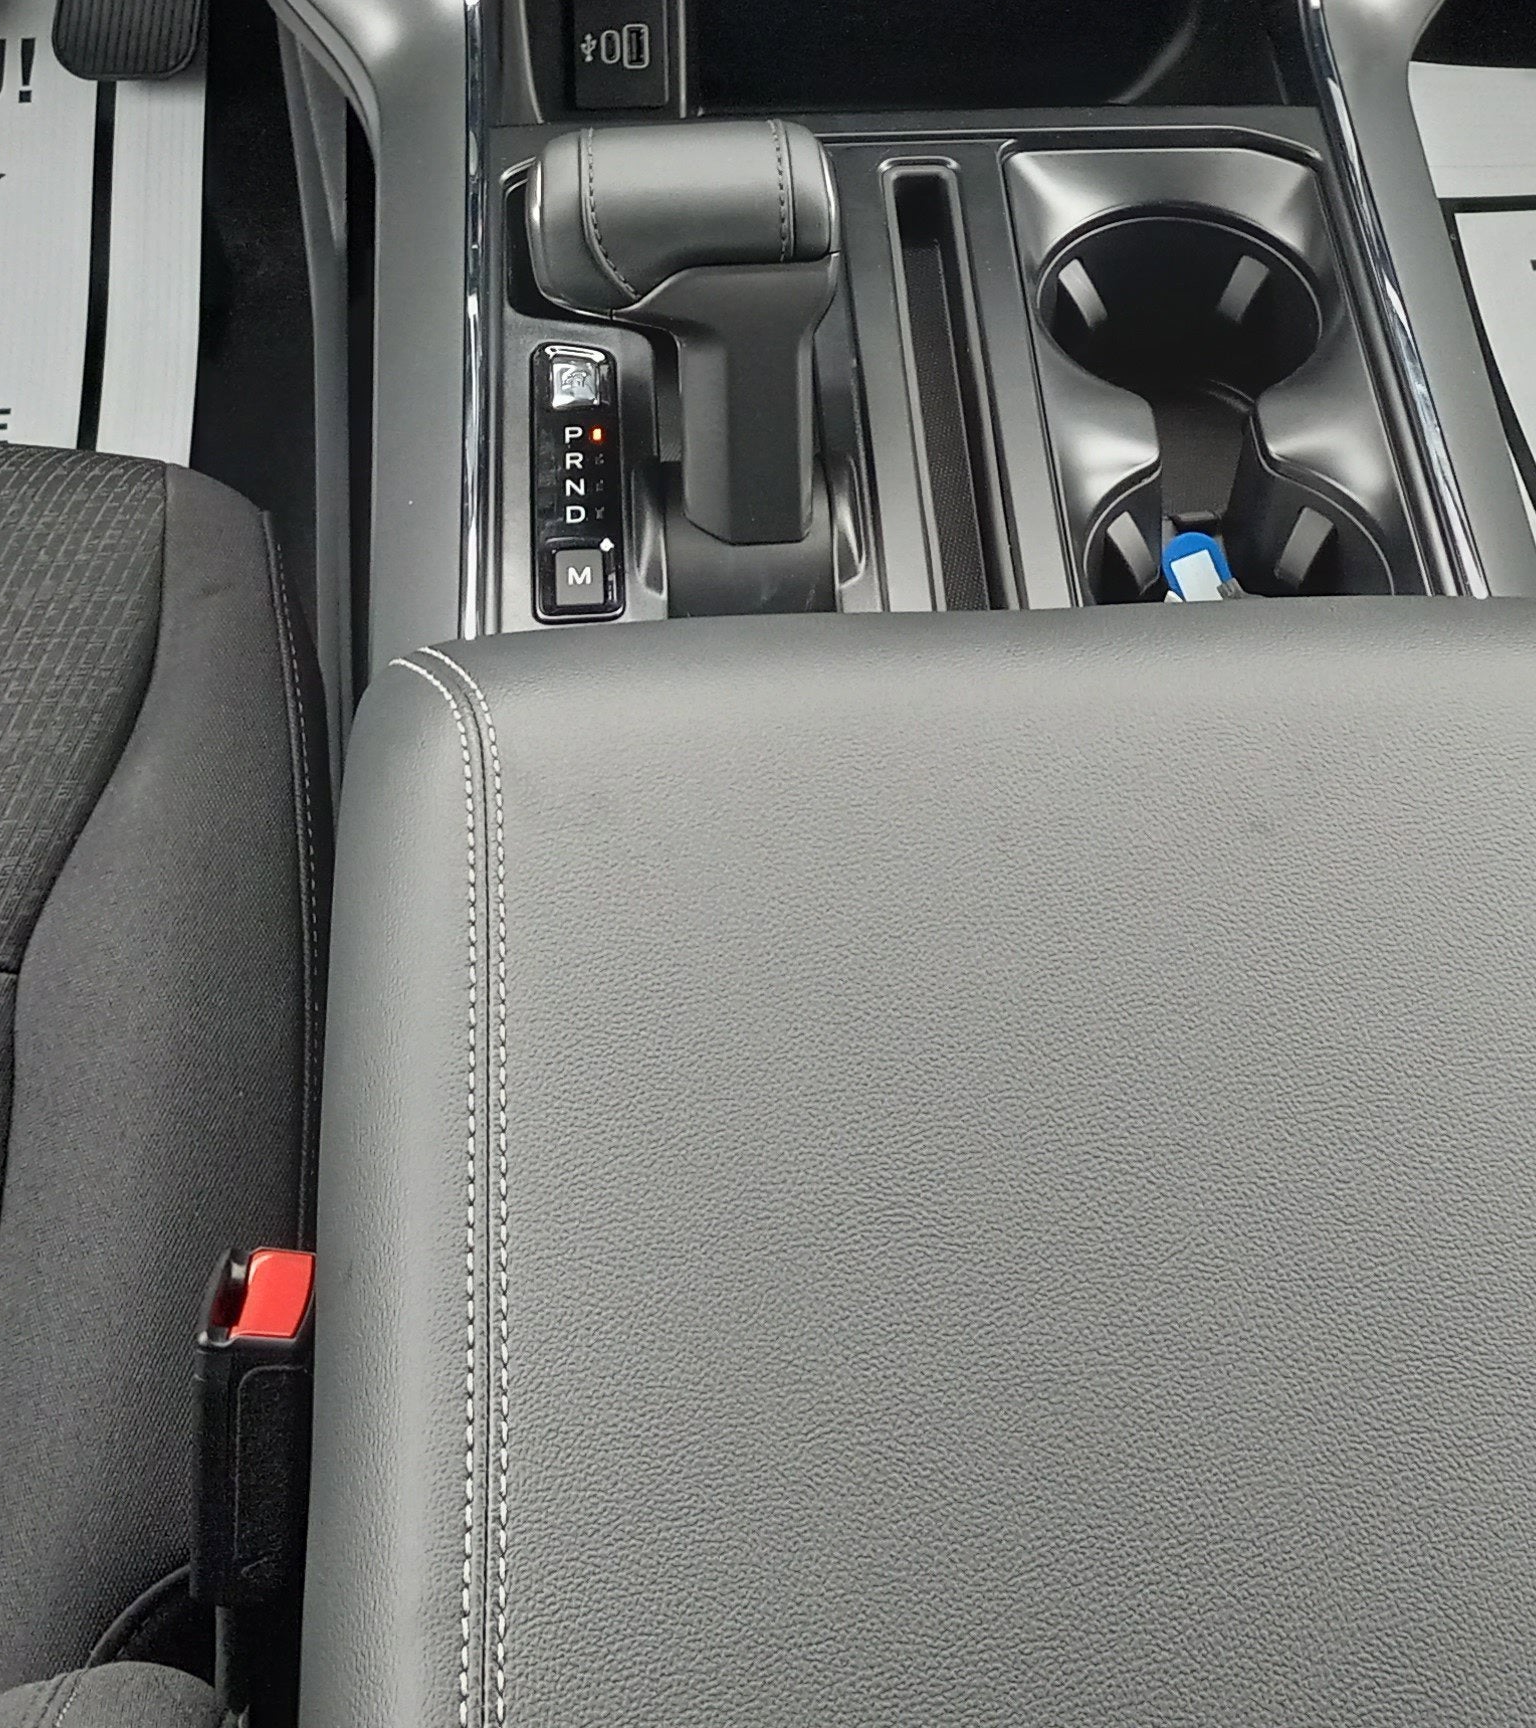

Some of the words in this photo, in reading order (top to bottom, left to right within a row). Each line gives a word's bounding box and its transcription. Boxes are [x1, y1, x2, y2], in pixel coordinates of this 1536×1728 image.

[565, 427, 583, 443] P
[565, 452, 584, 469] R
[565, 479, 585, 496] N
[566, 506, 586, 523] D
[568, 567, 592, 585] M
